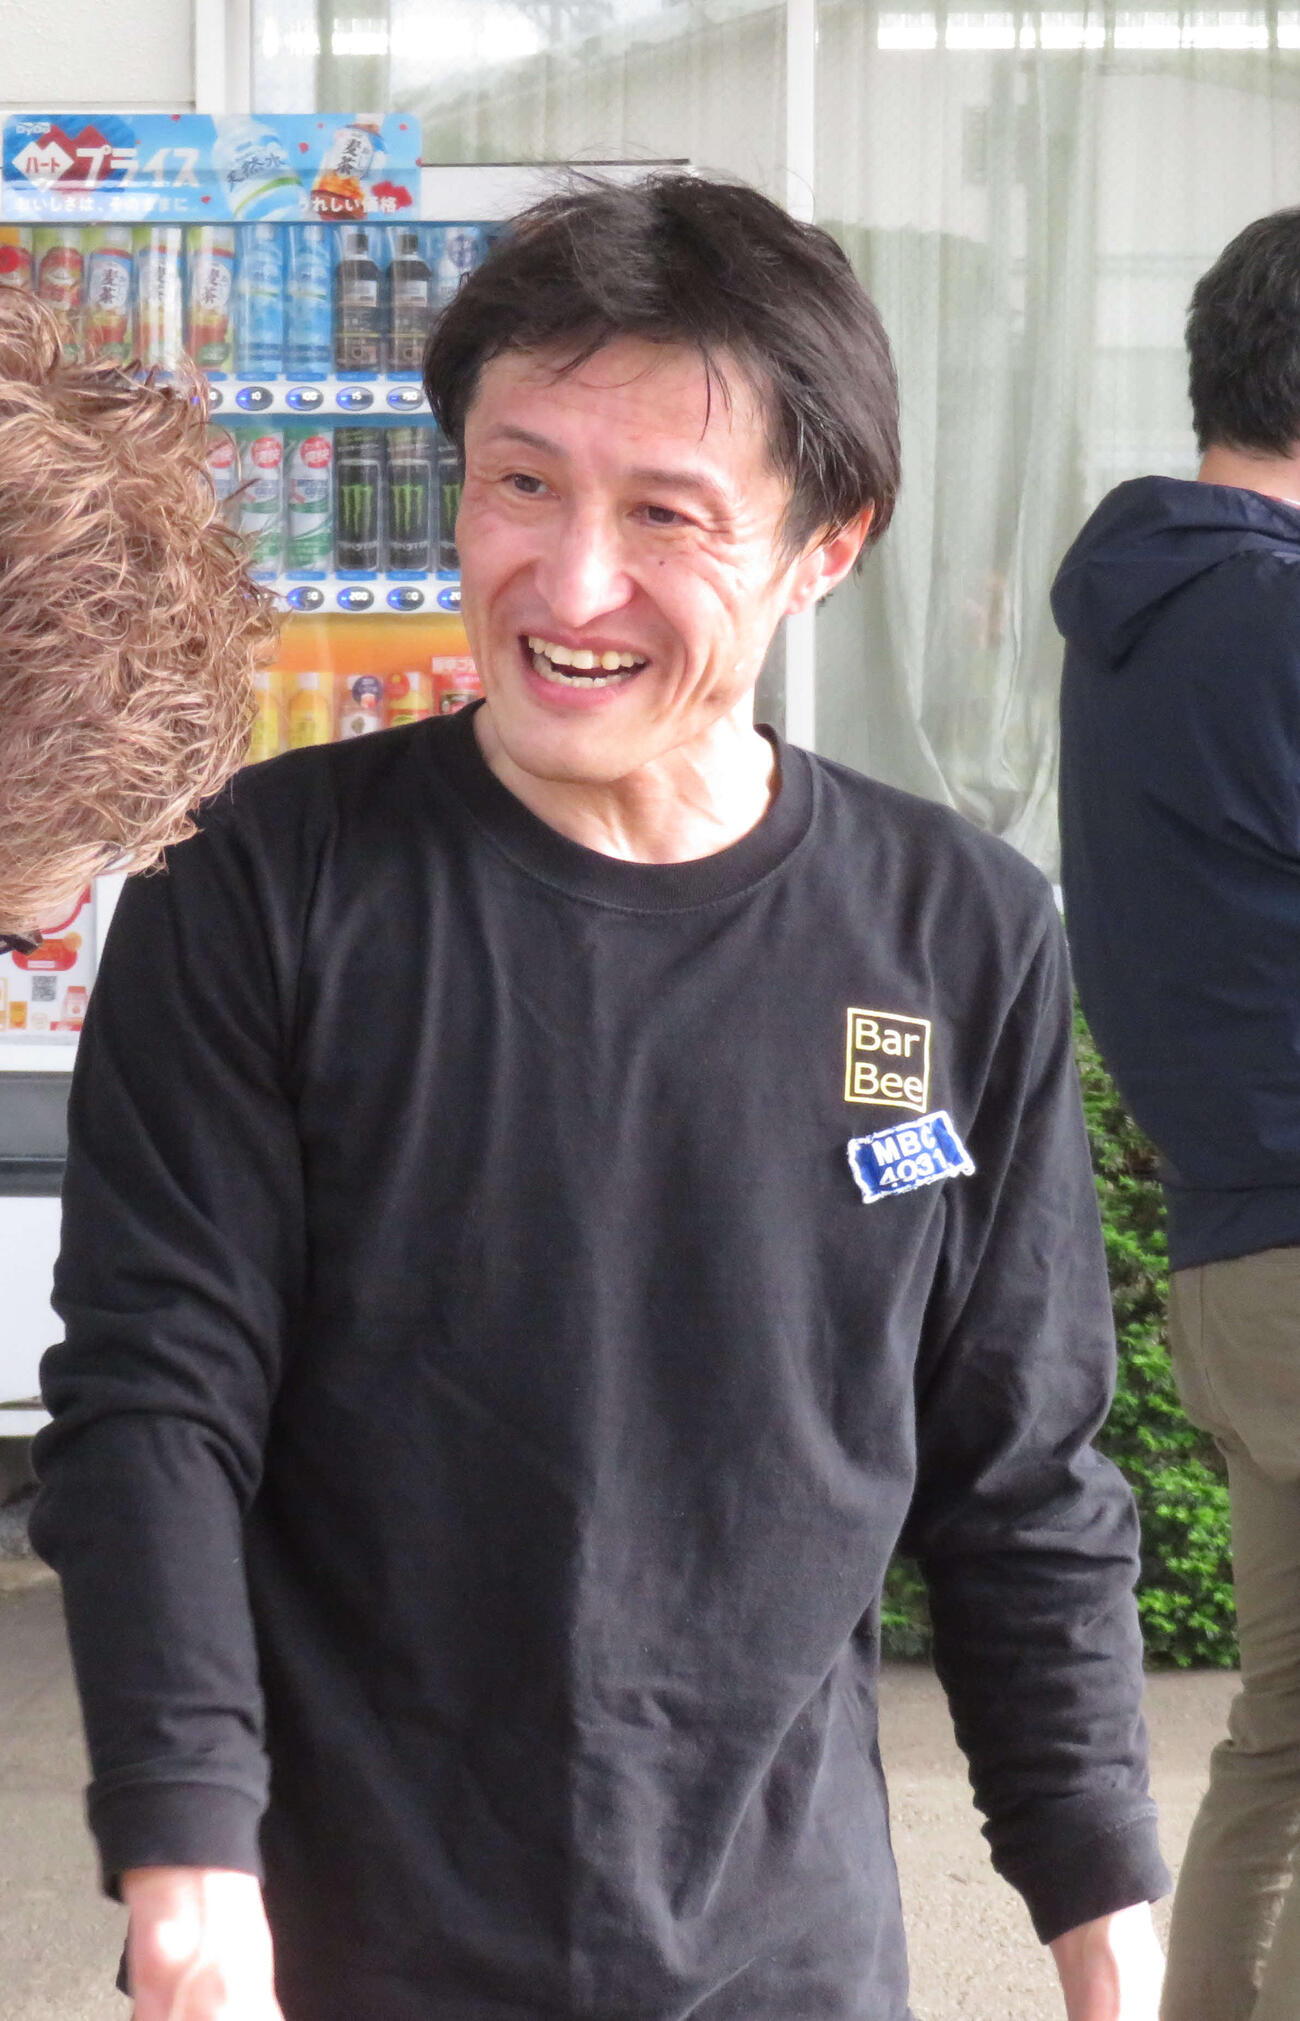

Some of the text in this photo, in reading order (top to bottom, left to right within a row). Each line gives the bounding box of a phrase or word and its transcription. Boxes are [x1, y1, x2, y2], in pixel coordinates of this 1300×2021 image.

[26, 144, 200, 188] ハート プライス
[855, 1018, 921, 1058] Bar
[853, 1062, 923, 1103] Bee
